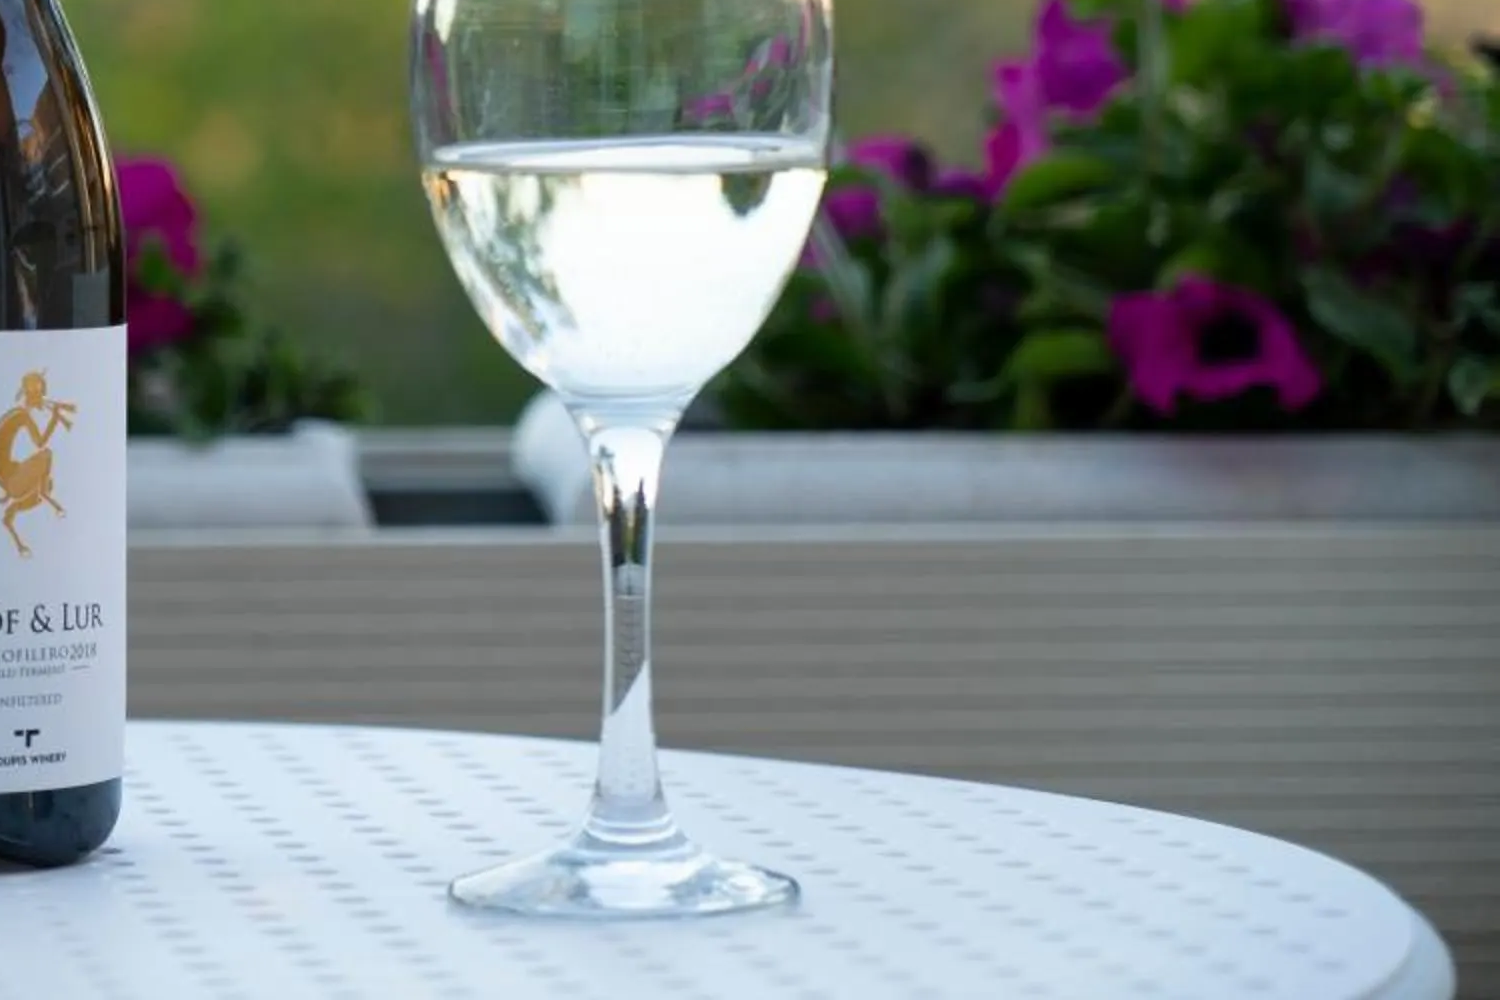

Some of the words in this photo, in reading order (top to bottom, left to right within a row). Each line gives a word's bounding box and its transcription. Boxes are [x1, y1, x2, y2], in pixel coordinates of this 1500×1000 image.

[30, 603, 54, 633] &
[62, 602, 103, 632] LUR
[30, 751, 67, 764] WINERY
